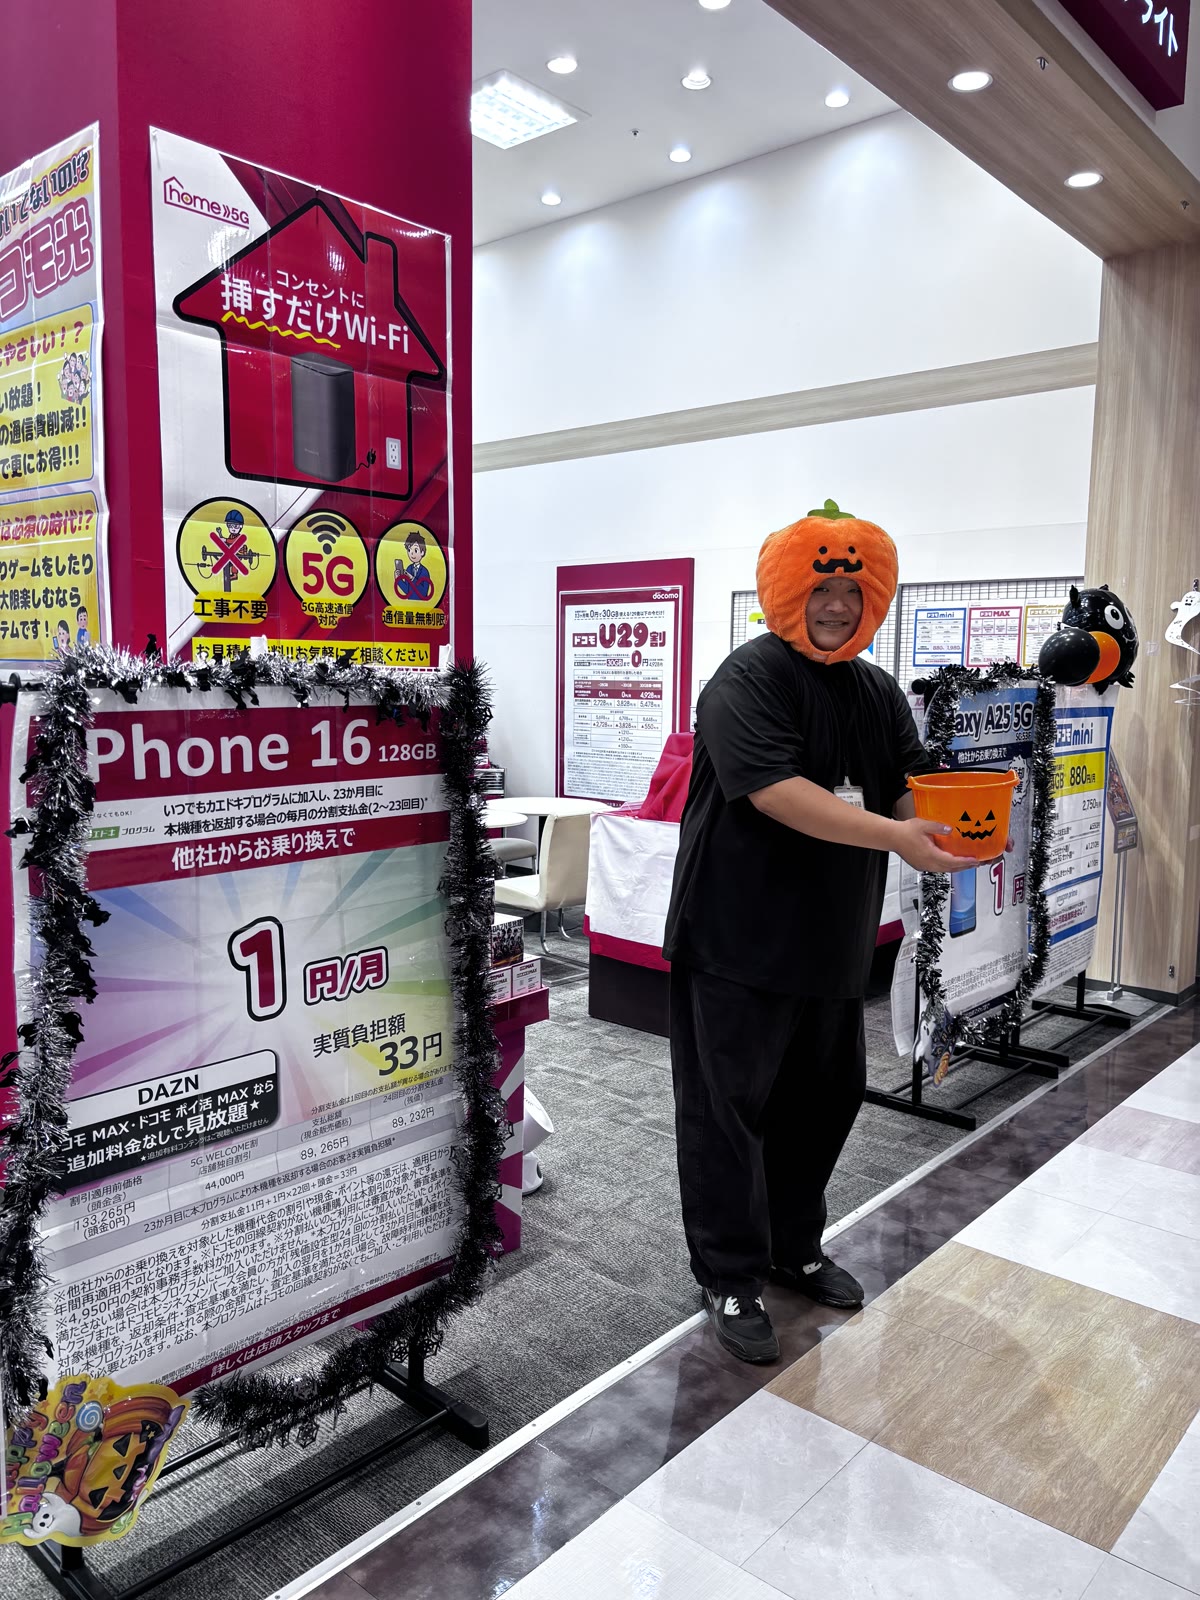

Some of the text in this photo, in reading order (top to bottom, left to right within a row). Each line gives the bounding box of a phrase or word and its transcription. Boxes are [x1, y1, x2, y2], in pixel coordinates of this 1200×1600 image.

[169, 184, 250, 225] home 5G
[276, 269, 365, 309] コンセントに
[220, 273, 409, 354] 挿すだけWi-Fi
[302, 552, 354, 597] 5G
[194, 598, 269, 619] 工事不要
[301, 601, 354, 615] 5G高速通信
[653, 591, 679, 600] docomo
[318, 615, 338, 626] 対応
[382, 609, 446, 627] 通信量無制限
[574, 622, 667, 649] ドコモ U29割
[984, 702, 1011, 734] A25
[1012, 701, 1034, 730] 5G
[310, 719, 372, 768] 16
[378, 744, 437, 763] 128GB
[1072, 722, 1093, 746] mini
[163, 785, 383, 818] いつでもカエドキプログラムに加入し、23か月目に
[121, 825, 155, 836] プログラム
[172, 827, 356, 872] 他社からお乗り換えで
[991, 861, 1025, 912] 1 円
[231, 919, 284, 1018] 1
[306, 949, 386, 1003] 円/月
[313, 1013, 406, 1059] 実質負担額
[379, 1032, 442, 1076] 33円
[137, 1074, 200, 1106] DAZN
[175, 1096, 213, 1118] ポイ活
[217, 1087, 249, 1106] MAX
[253, 1080, 274, 1096] なら
[383, 1077, 444, 1104] 24回目の分割支払金
[404, 1093, 424, 1107] (残価)
[300, 1117, 352, 1143] (現金販売価格)
[312, 1110, 343, 1128] 支払総額
[190, 1138, 259, 1168] 5G WELCOME割
[199, 1151, 252, 1176] 店舗独自割引
[70, 1176, 143, 1207] 割引適用前価格
[205, 1171, 245, 1191] 44,000円
[87, 1192, 127, 1213] (頭金含)
[84, 1214, 131, 1240] (頭金0円)
[210, 1308, 341, 1378] 詳しくは店頭スタッフまで
[2, 1381, 87, 1536] Halloween
